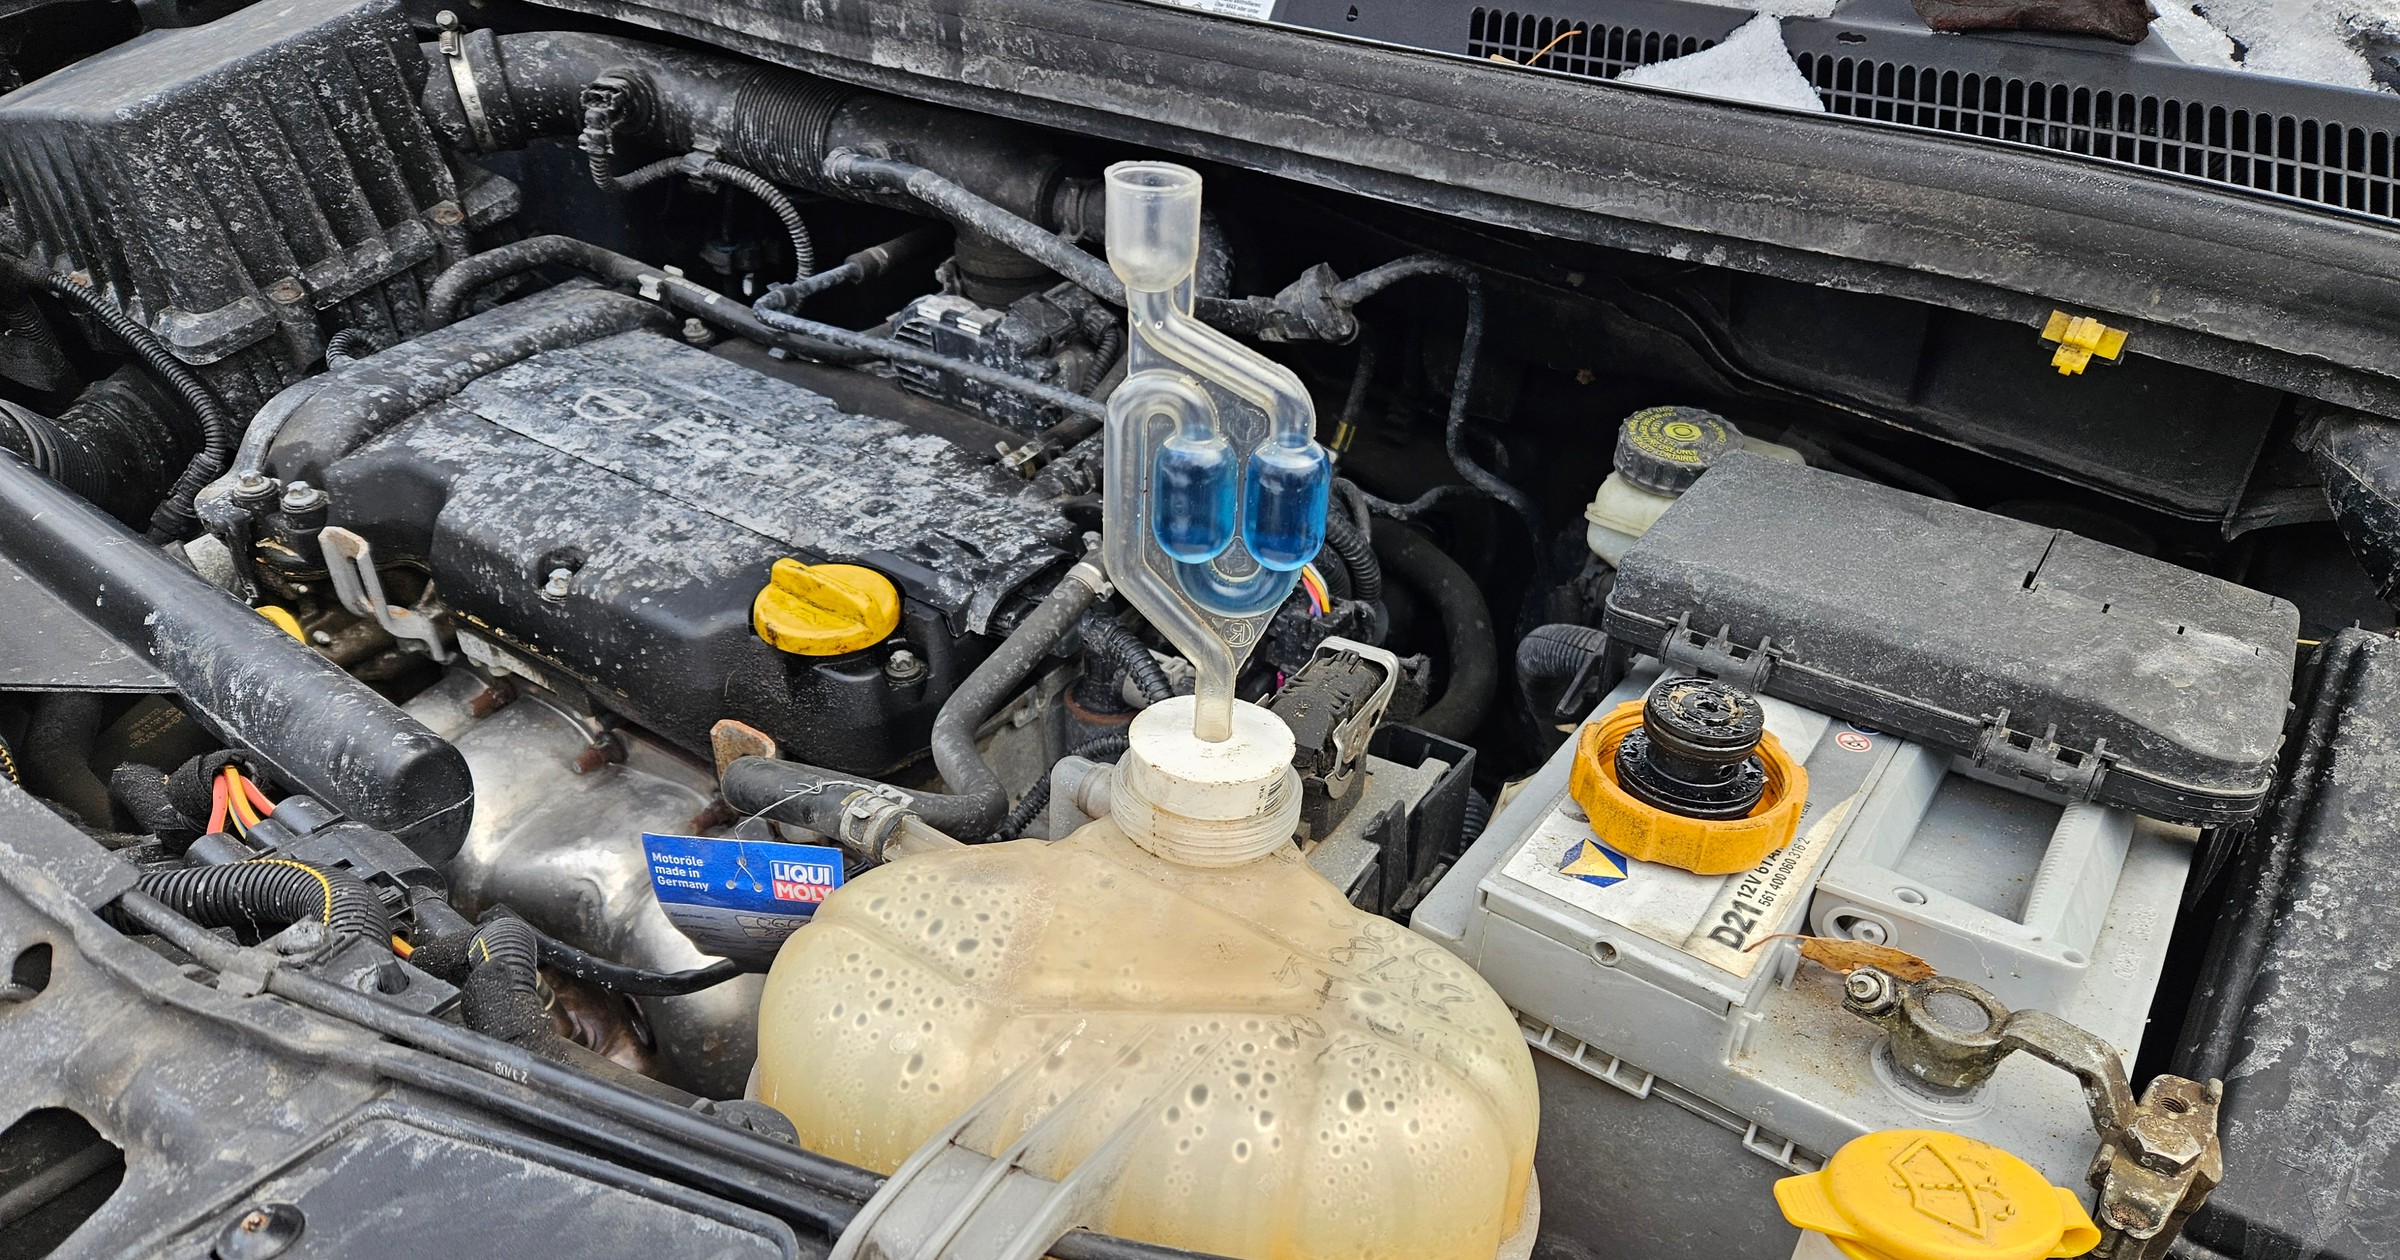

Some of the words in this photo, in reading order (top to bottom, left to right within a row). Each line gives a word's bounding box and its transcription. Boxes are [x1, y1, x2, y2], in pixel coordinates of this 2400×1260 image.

[652, 851, 704, 867] Motoröle
[655, 865, 685, 878] made
[688, 866, 700, 878] in
[773, 863, 830, 886] LIQUI
[1758, 890, 1777, 907] 561
[1769, 873, 1787, 891] 400
[1779, 857, 1797, 875] 060
[1789, 843, 1806, 859] 316
[1798, 837, 1811, 845] 2
[657, 877, 709, 892] Germany
[775, 883, 834, 901] MOLY
[1737, 874, 1762, 899] 12V
[1707, 899, 1764, 952] D21
